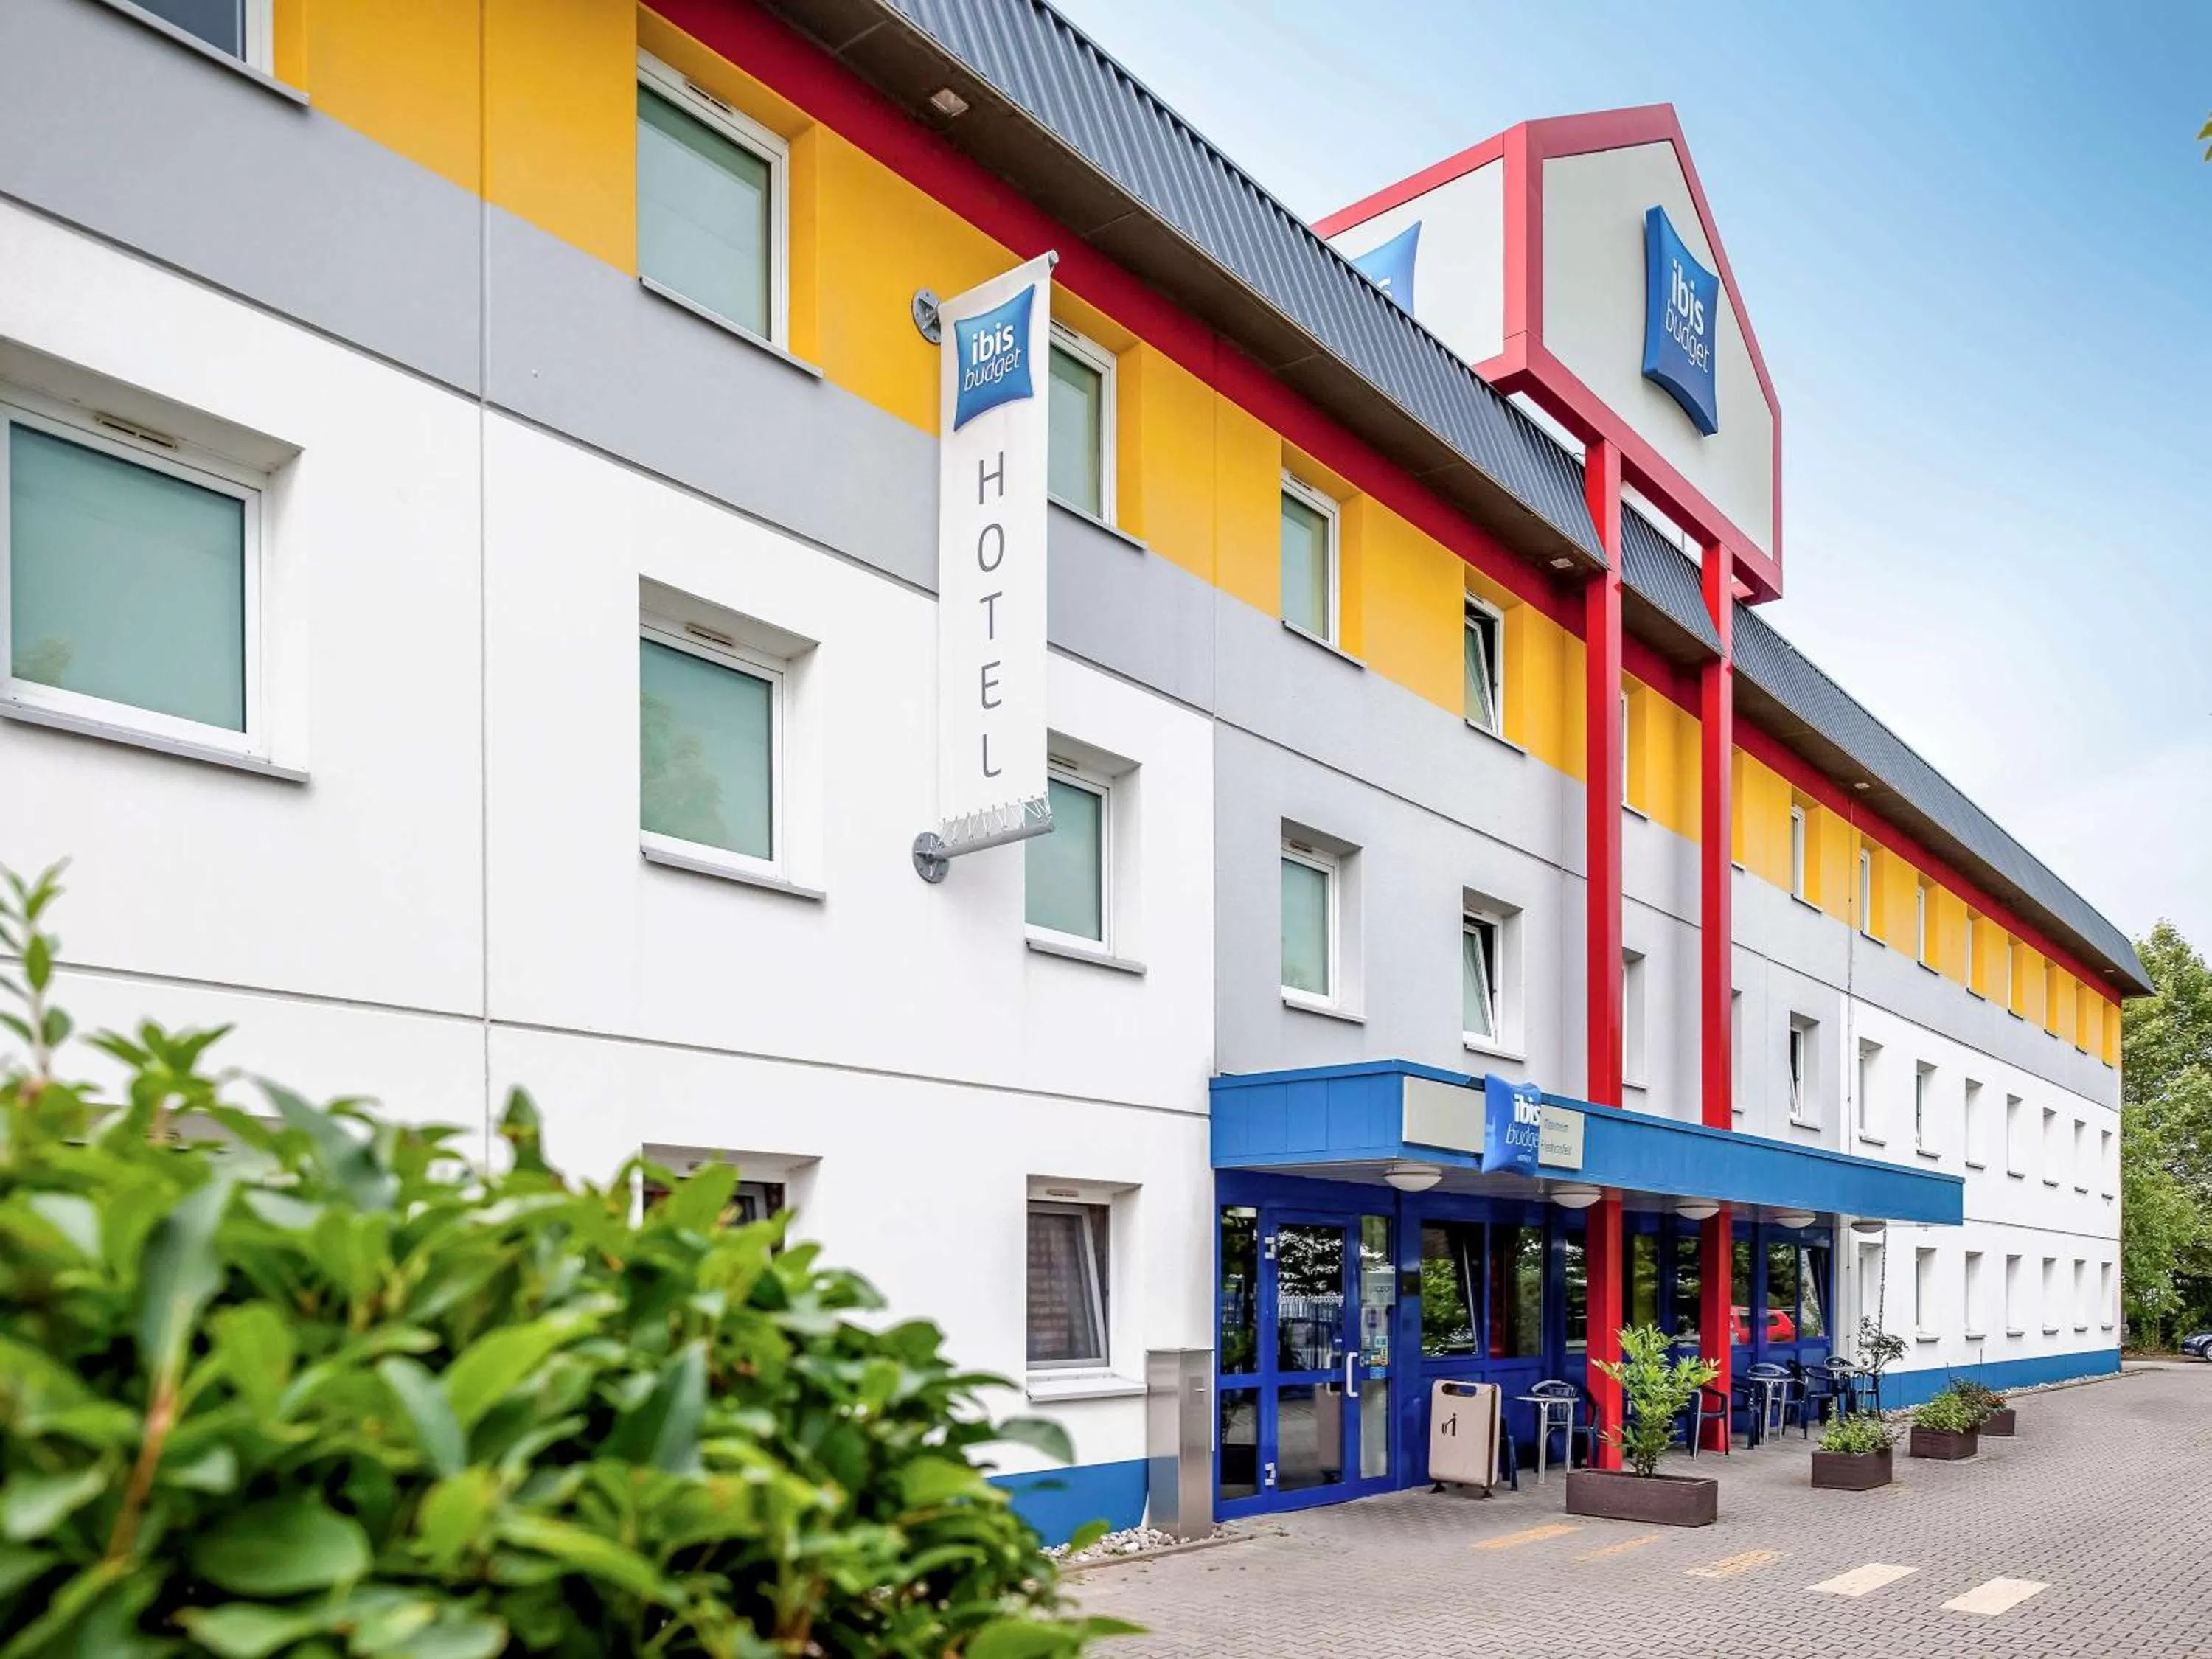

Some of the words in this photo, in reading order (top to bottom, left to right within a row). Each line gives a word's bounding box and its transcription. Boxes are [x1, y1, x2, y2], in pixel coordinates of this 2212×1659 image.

[1671, 258, 1705, 335] ibis
[971, 322, 1015, 365] ibis
[1665, 298, 1710, 373] budget
[964, 348, 1021, 392] budget
[978, 451, 1005, 778] HOTEL
[1514, 1093, 1540, 1126] ibis
[1505, 1121, 1540, 1152] budge
